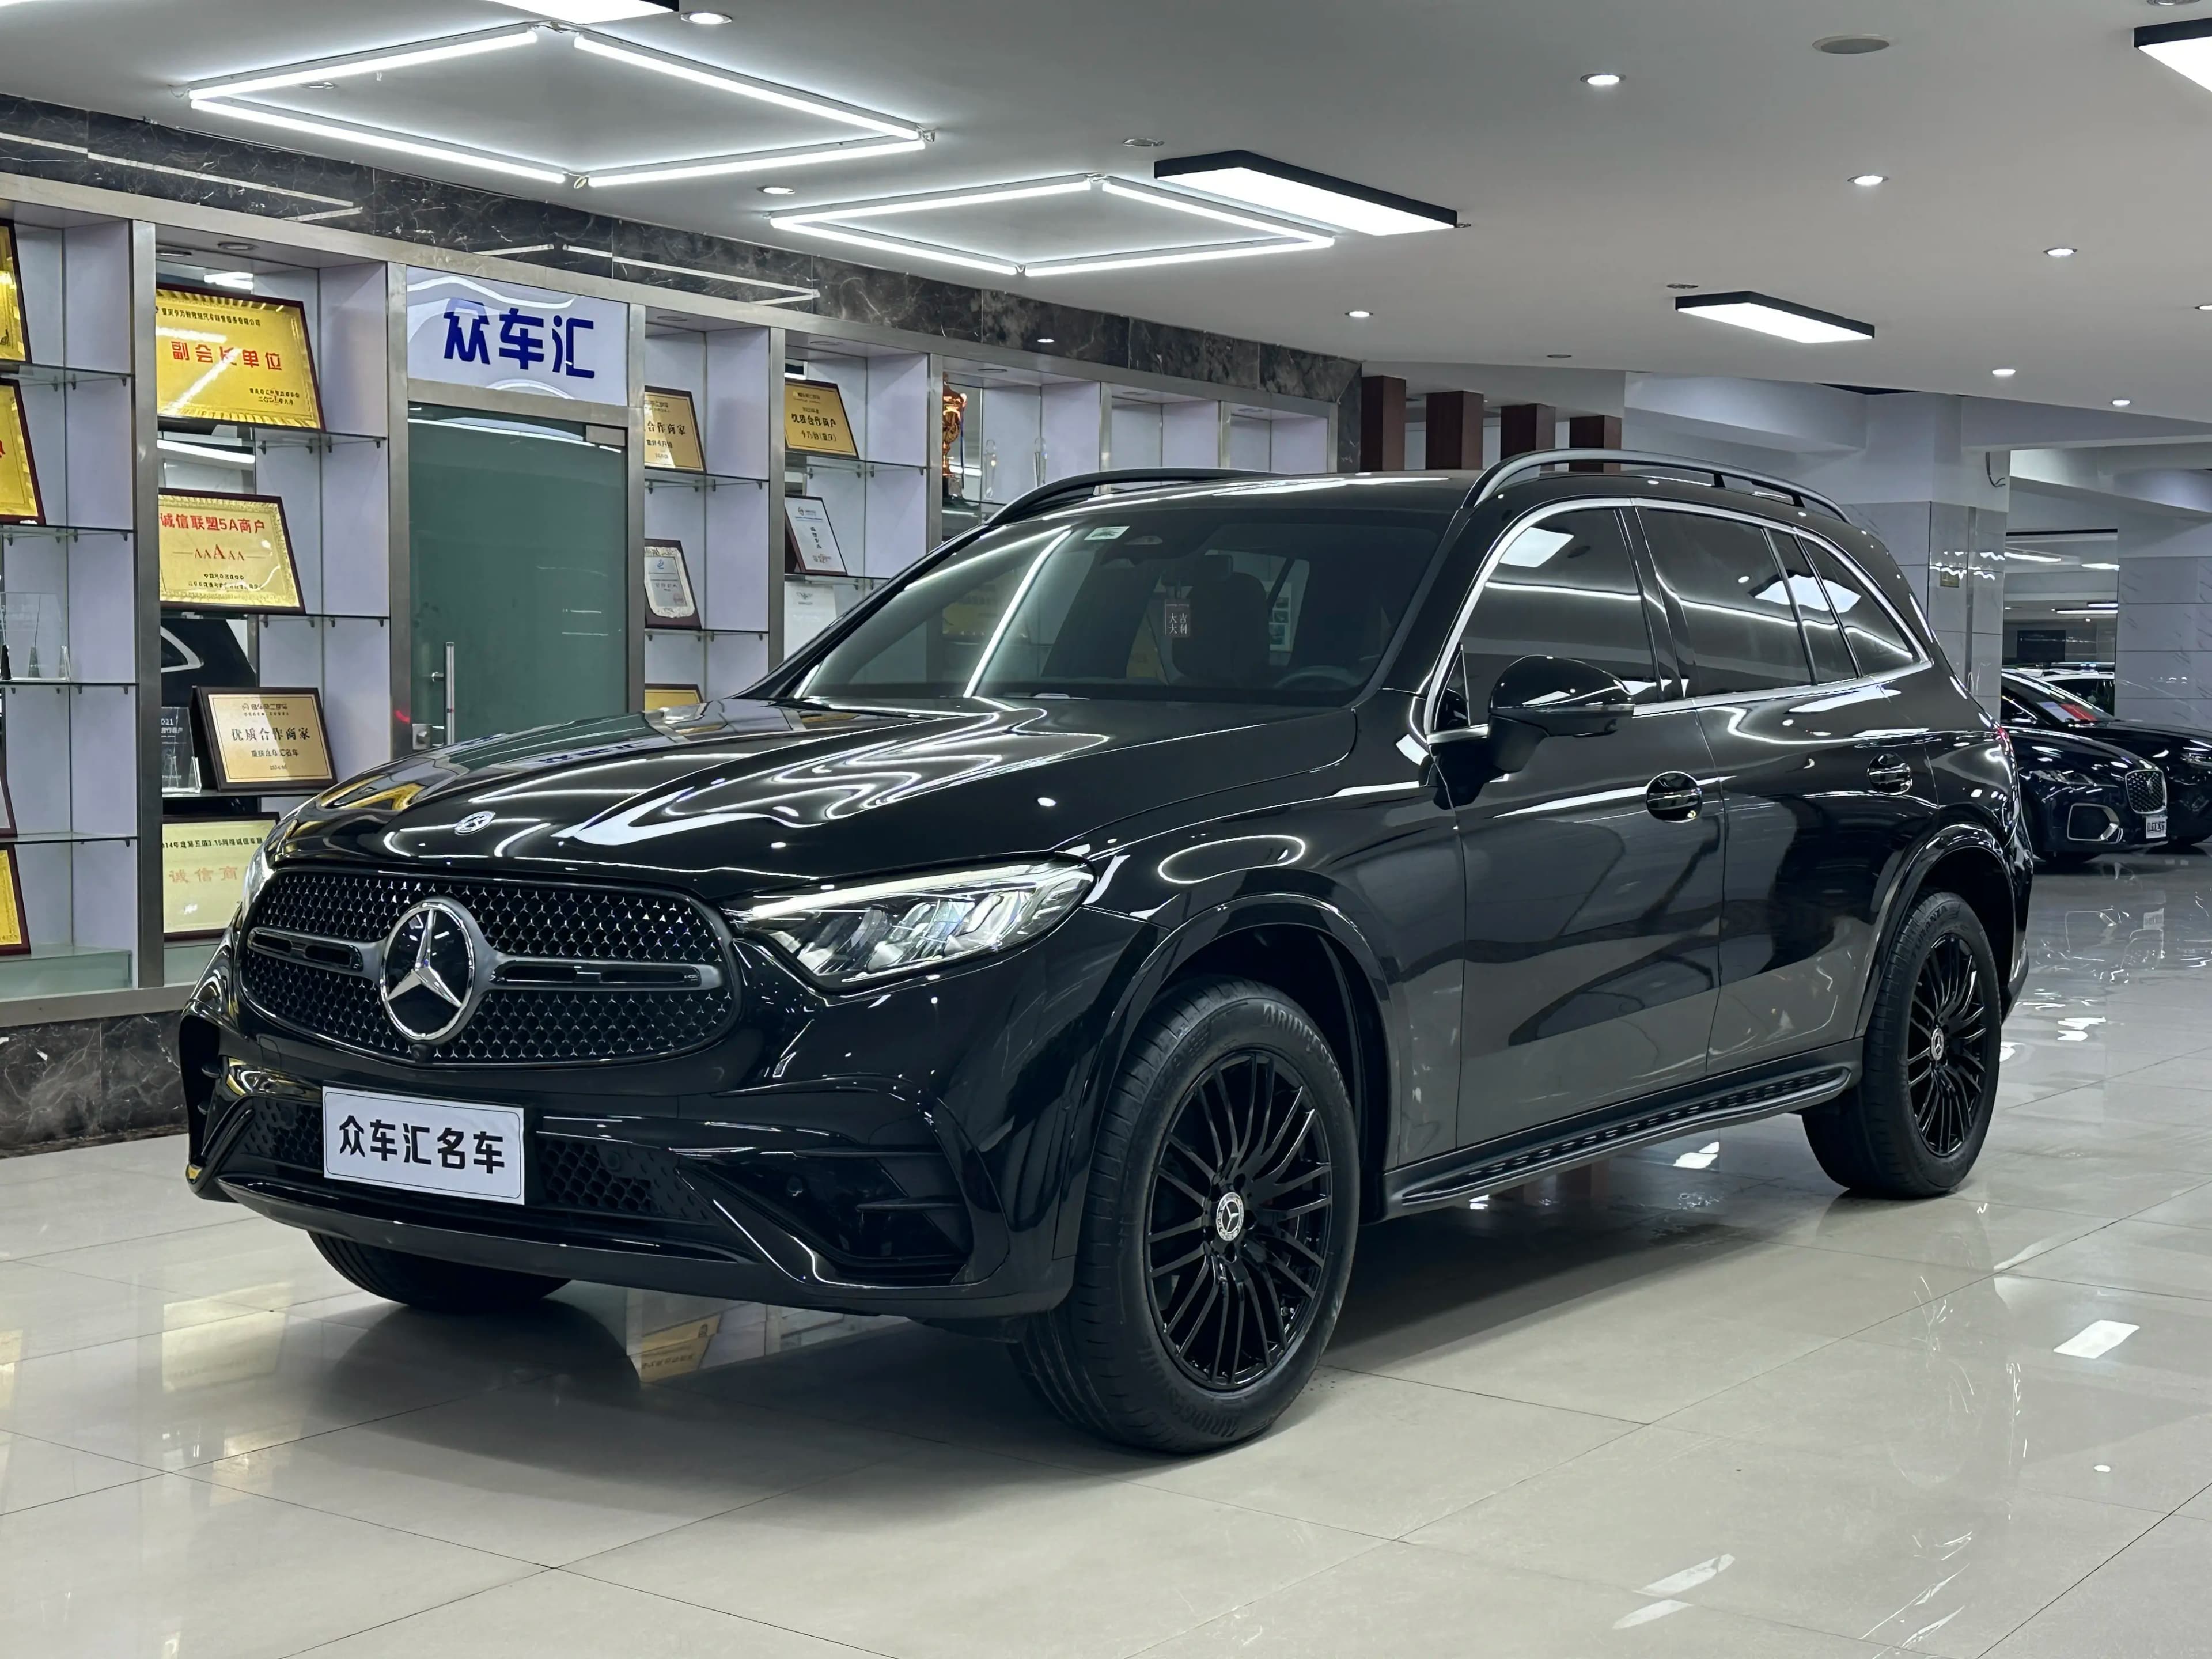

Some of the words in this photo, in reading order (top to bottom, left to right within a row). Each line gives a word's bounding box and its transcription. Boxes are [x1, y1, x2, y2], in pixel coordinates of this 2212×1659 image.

[443, 297, 595, 379] 众车汇
[171, 340, 282, 370] 副会长单位
[160, 513, 265, 533] 诚信联盟5A商户
[232, 728, 310, 741] 优质合作商家
[339, 1115, 505, 1175] 众车汇名车
